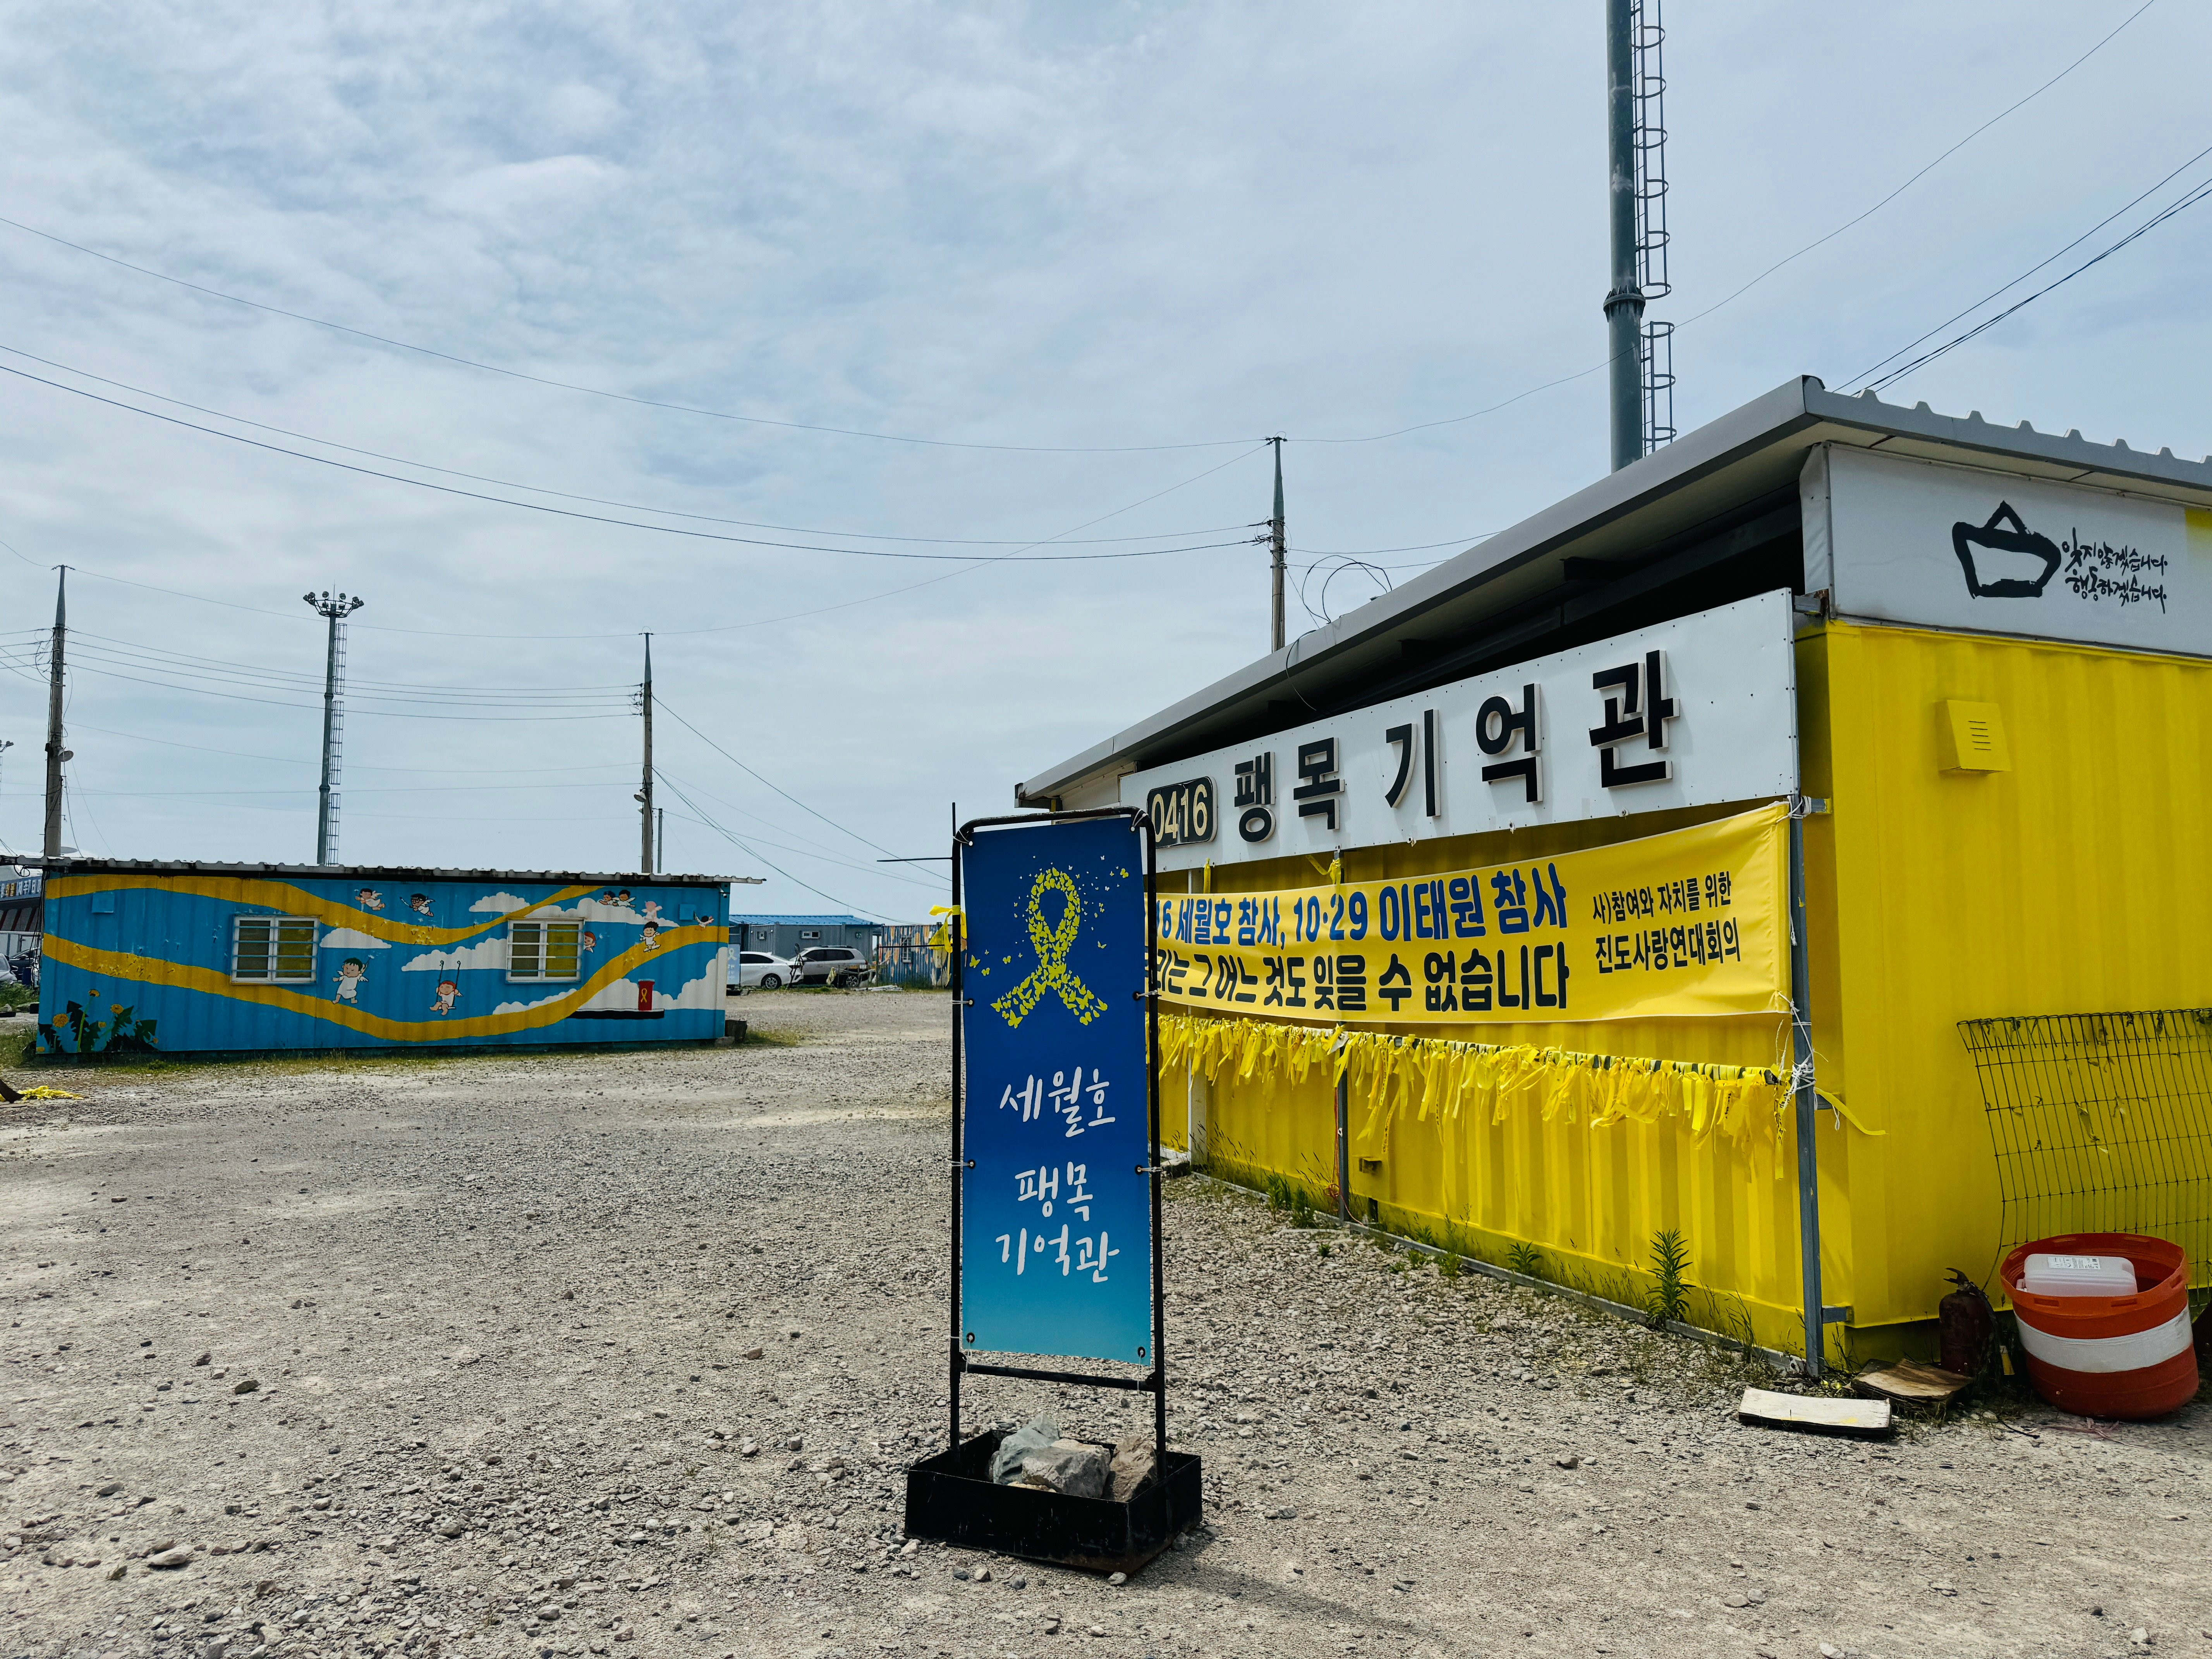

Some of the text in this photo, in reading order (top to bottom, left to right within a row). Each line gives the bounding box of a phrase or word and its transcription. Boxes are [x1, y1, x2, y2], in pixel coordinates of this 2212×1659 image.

[1151, 784, 1208, 843] 0416
[1175, 897, 1232, 945] 세월호
[1238, 895, 1285, 950] 참사,
[1379, 874, 1486, 942] 이태원
[1491, 862, 1568, 934] 참사
[1592, 871, 1731, 925] 사)참여와 자치를 위한
[1595, 917, 1741, 974] 진도사랑연대회의
[1263, 955, 1306, 1007] 것도
[1314, 955, 1367, 1011] 잊을
[1378, 953, 1412, 1012] 수
[1423, 941, 1570, 1012] 없습니다
[999, 1066, 1116, 1138] 세월호
[1014, 1161, 1093, 1222] 팽목
[995, 1223, 1120, 1283] 기억관
